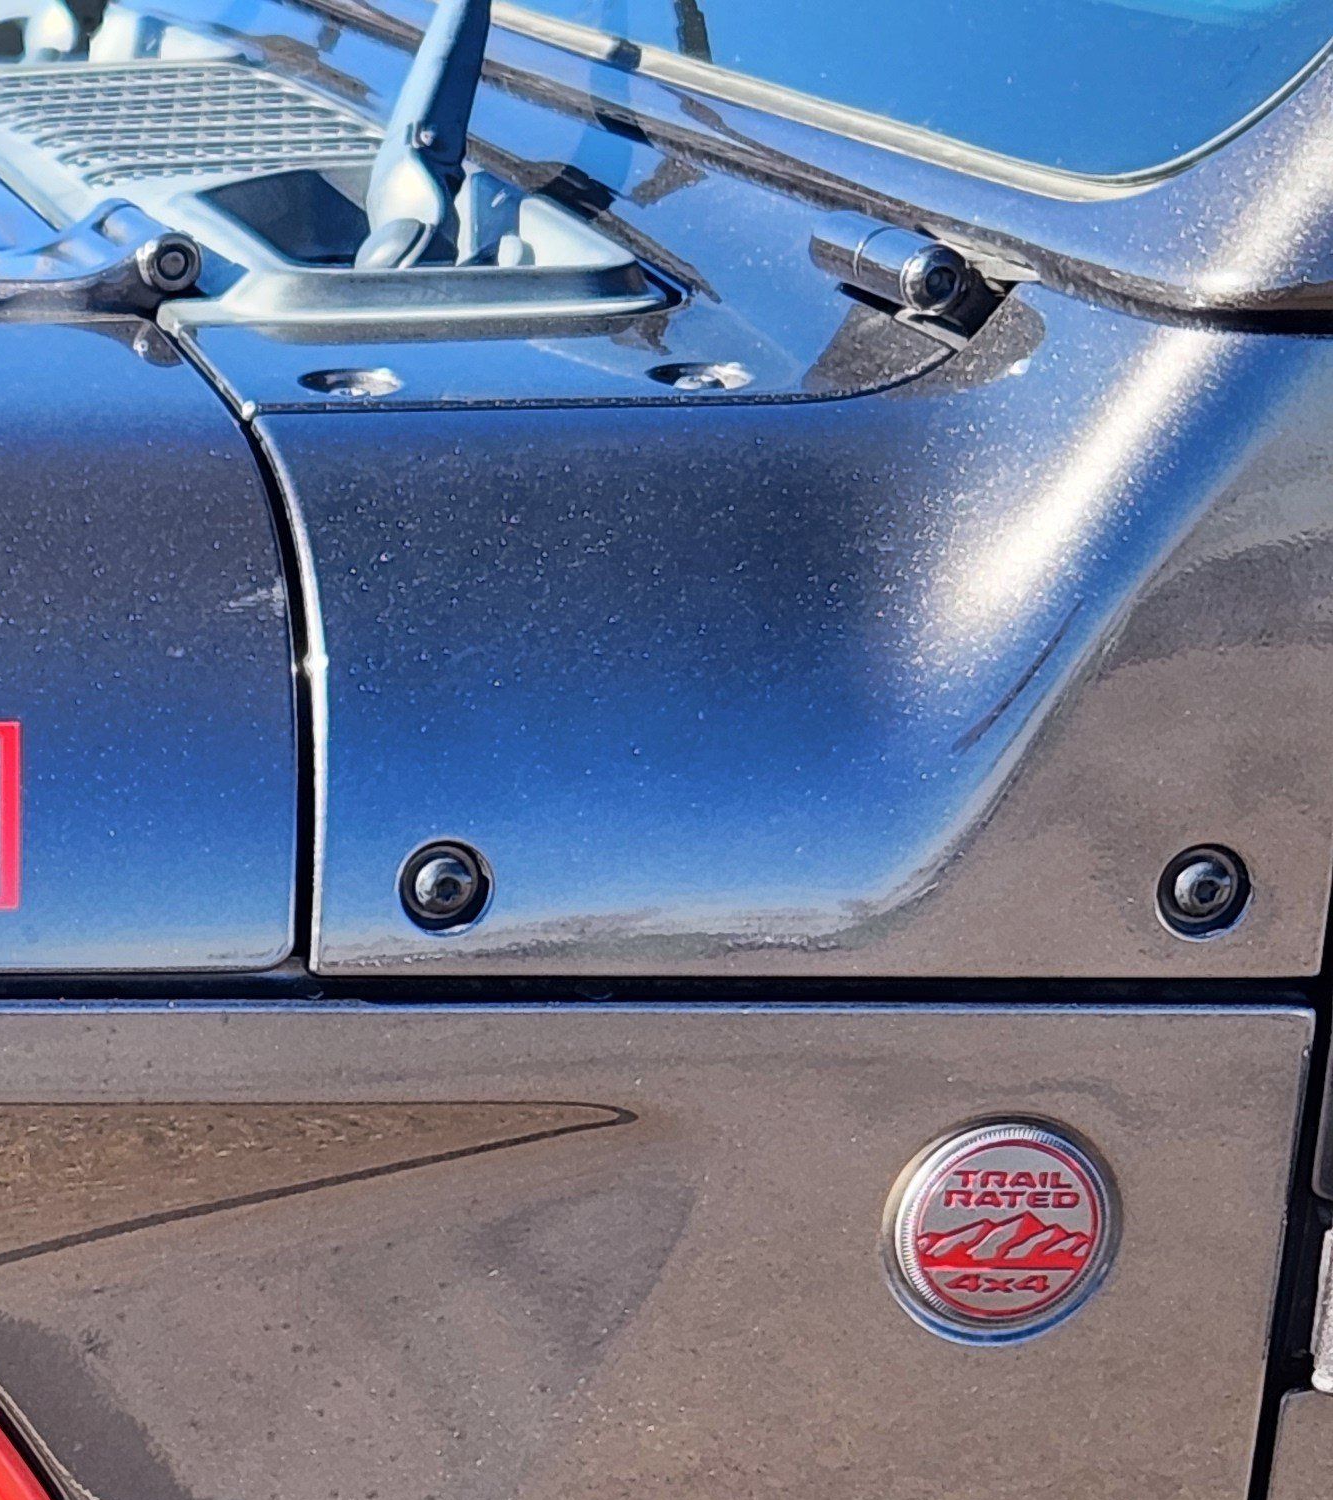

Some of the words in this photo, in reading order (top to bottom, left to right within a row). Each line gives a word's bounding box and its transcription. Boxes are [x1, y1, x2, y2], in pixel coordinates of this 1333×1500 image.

[952, 1169, 1073, 1190] TRAIL
[943, 1190, 1081, 1209] RATED
[943, 1273, 1050, 1294] 4x4
